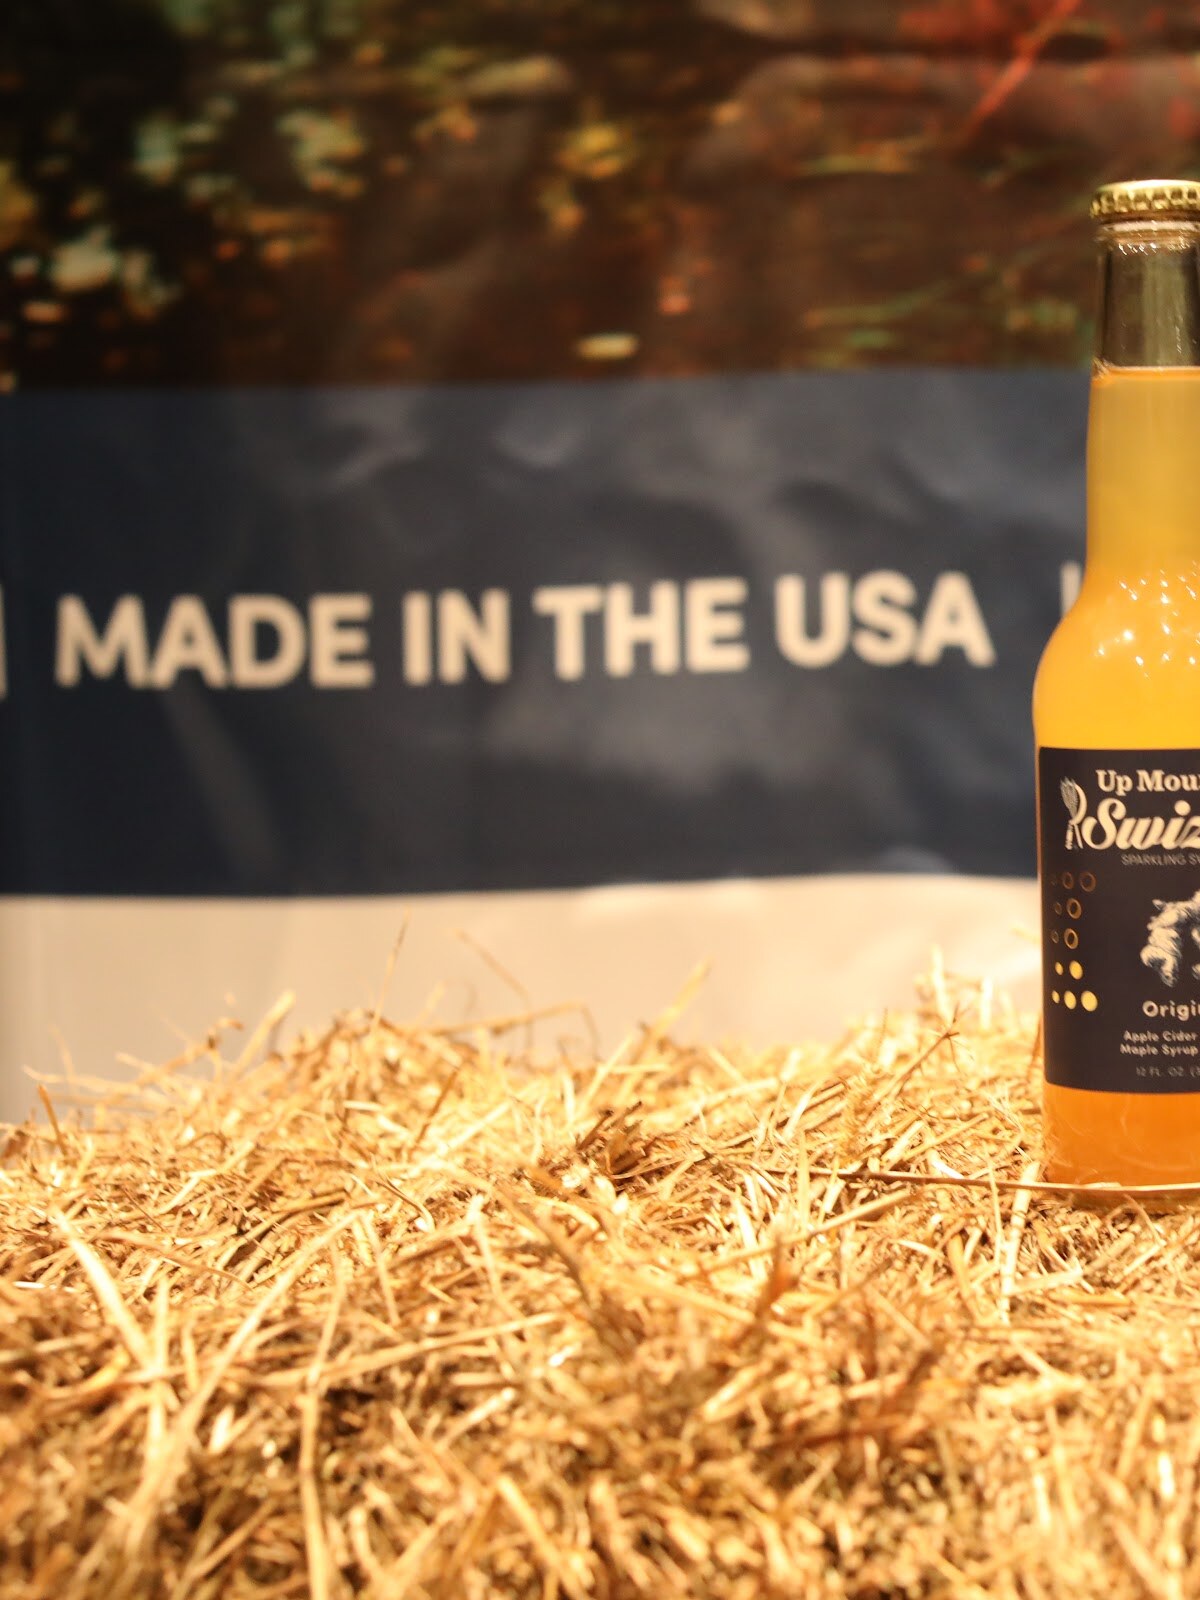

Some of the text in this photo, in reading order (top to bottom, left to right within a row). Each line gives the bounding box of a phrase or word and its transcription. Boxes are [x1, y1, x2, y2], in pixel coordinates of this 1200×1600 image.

[56, 595, 374, 689] MADE
[404, 590, 510, 686] IN
[532, 578, 750, 681] THE
[774, 570, 996, 668] USA
[1096, 769, 1133, 796] Up
[1121, 853, 1186, 866] SPARKLING
[1123, 1030, 1159, 1043] Apple
[1162, 1030, 1198, 1042] Cider
[1120, 1043, 1158, 1057] Maple
[1161, 1043, 1198, 1057] Syrup
